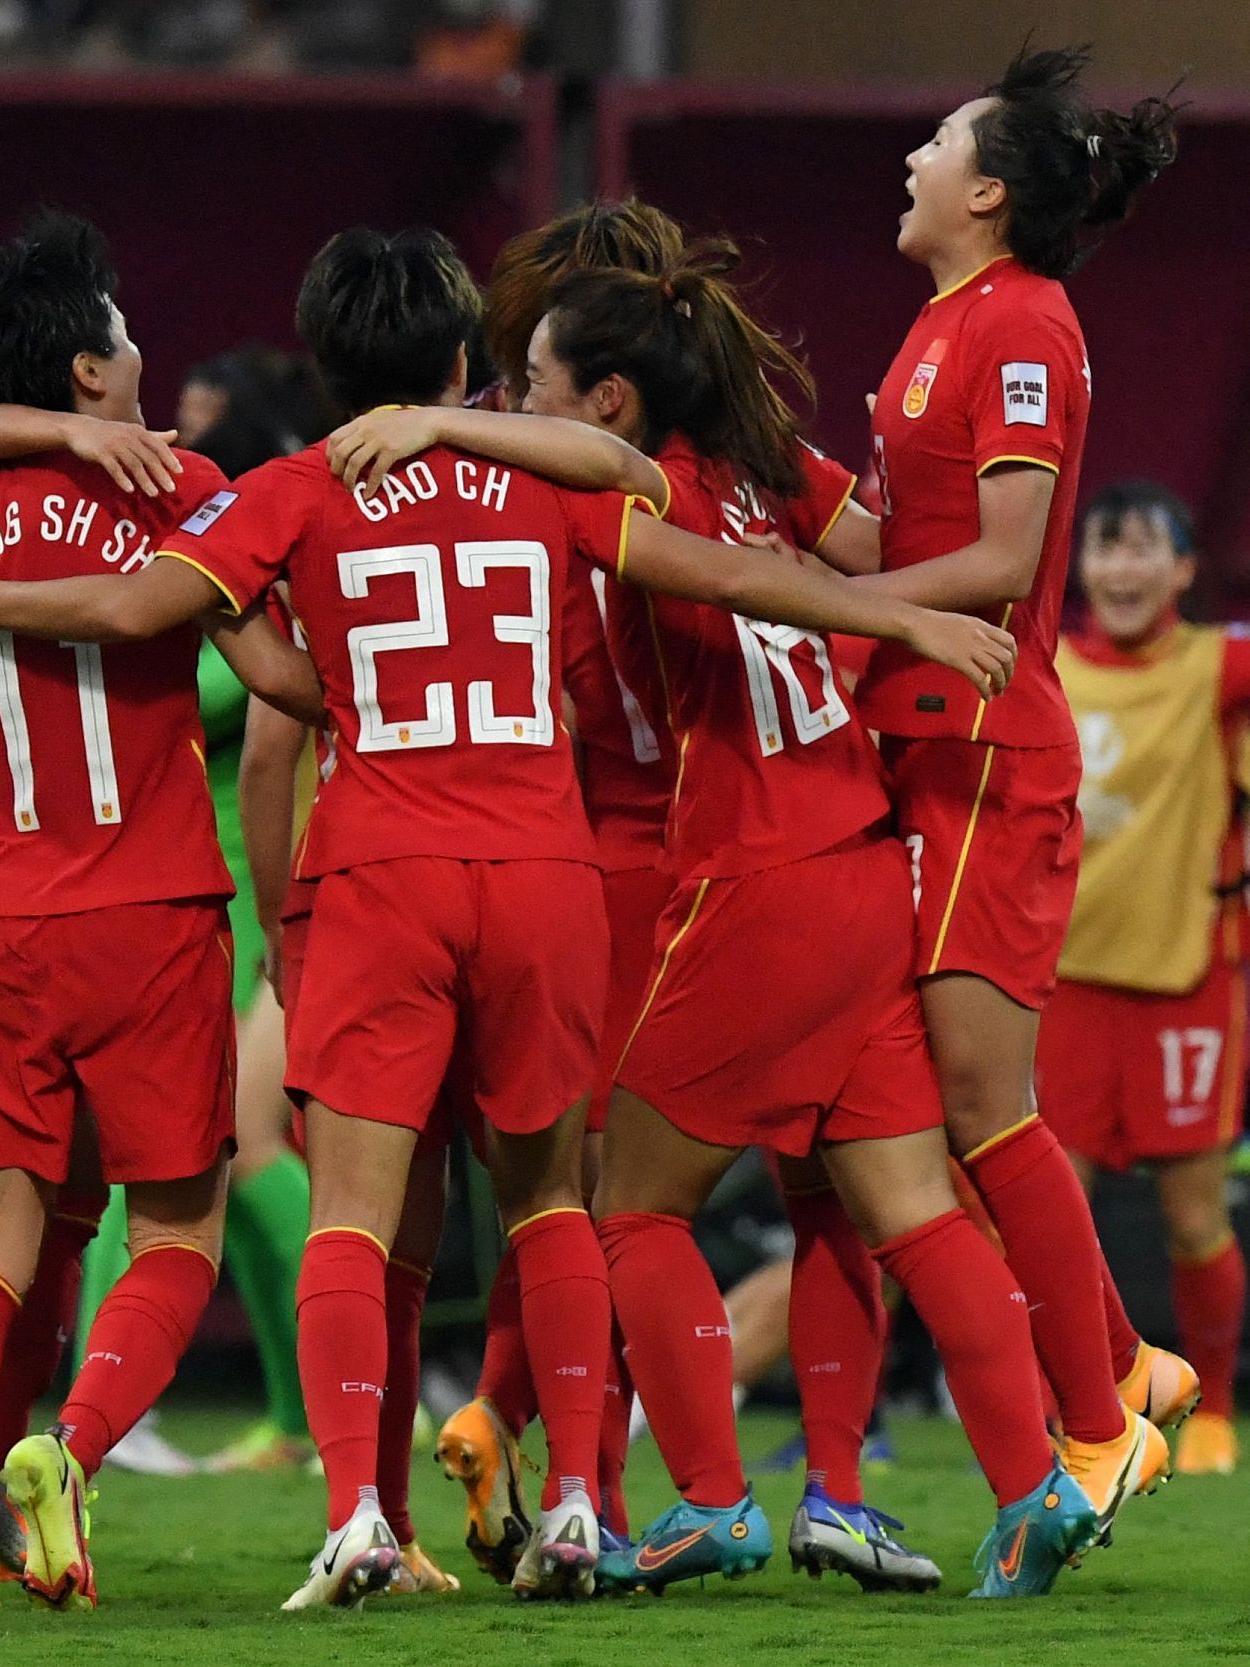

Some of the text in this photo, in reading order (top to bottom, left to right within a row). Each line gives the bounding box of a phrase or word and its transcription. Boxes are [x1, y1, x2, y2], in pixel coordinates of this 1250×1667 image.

[1006, 381, 1043, 394] OUR GOAL
[1009, 394, 1041, 407] FOR ALL
[353, 460, 511, 522] GAO CH
[40, 495, 98, 547] SH
[337, 541, 554, 753] 23
[1157, 1026, 1222, 1102] 17
